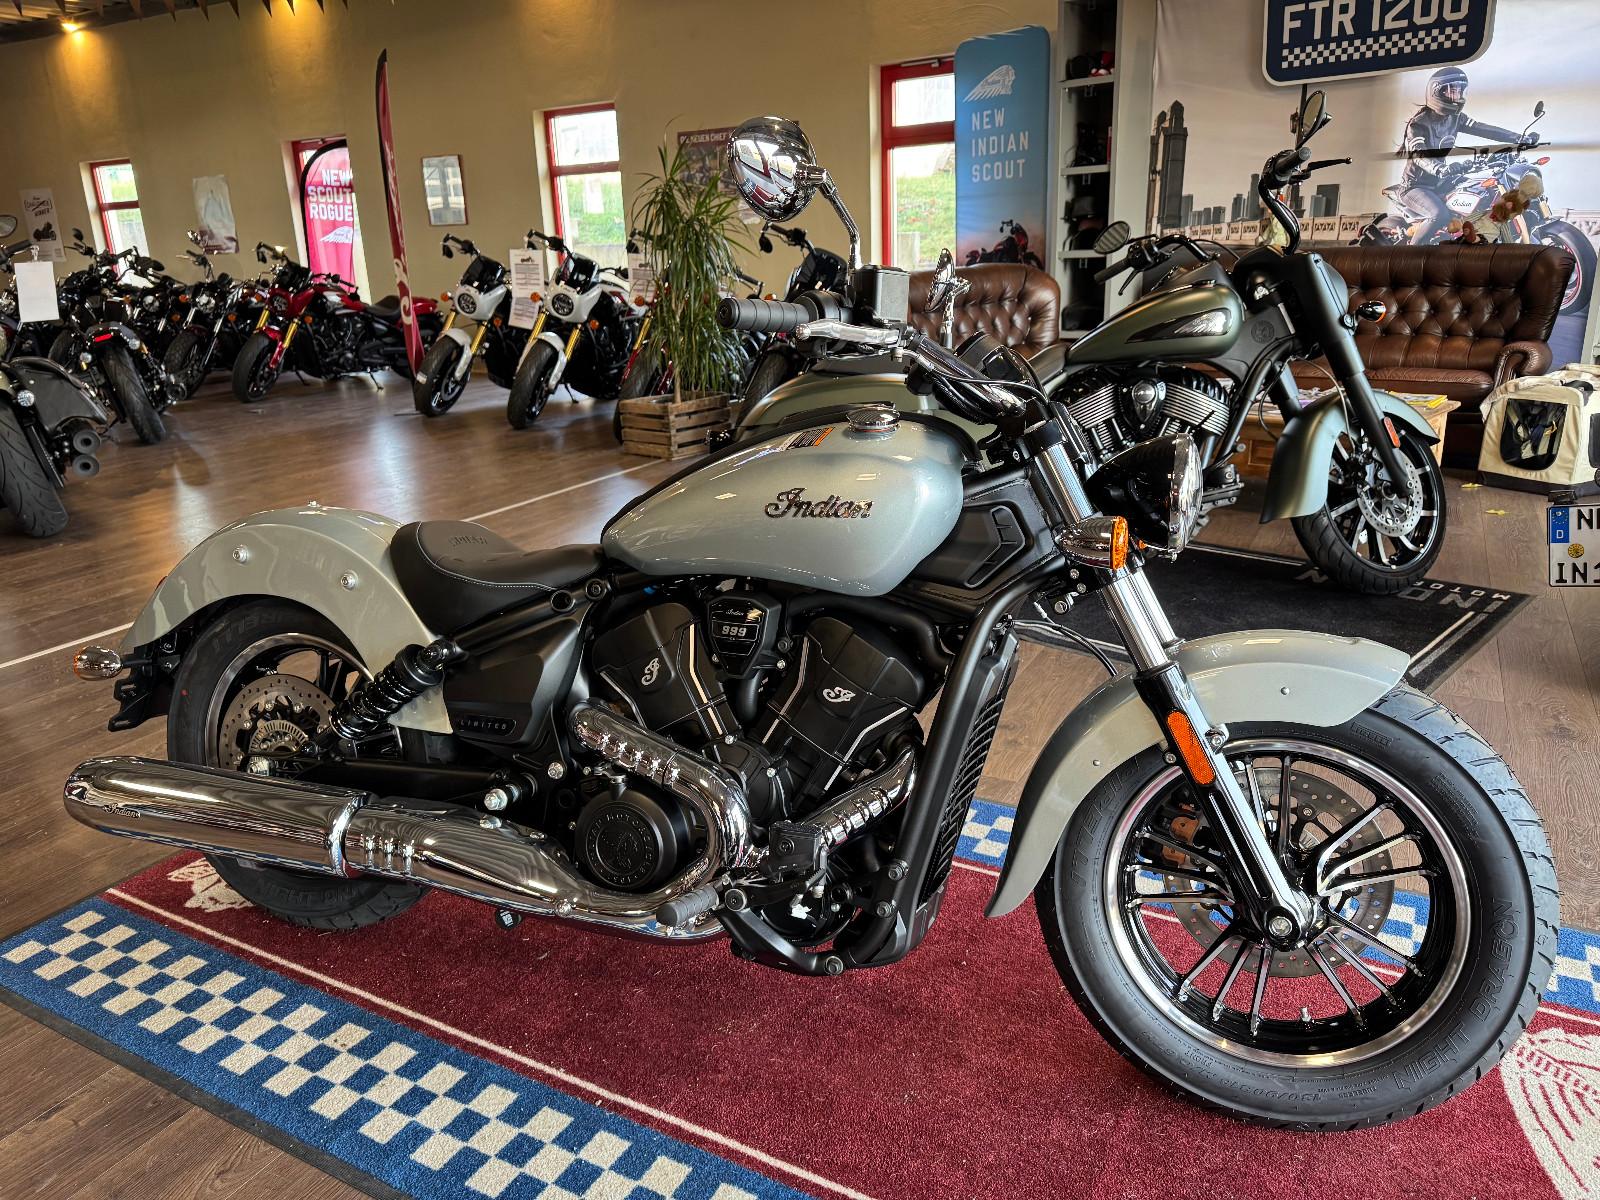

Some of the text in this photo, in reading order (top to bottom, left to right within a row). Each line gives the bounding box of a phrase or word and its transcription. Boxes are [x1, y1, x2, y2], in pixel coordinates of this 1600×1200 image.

[1282, 0, 1470, 44] FTR 1200
[972, 107, 1005, 131] NEW
[972, 131, 1029, 157] INDIAN
[321, 168, 353, 186] NEW
[972, 158, 1026, 183] SCOUT
[307, 185, 352, 204] SCOUT
[308, 202, 354, 222] ROGUE
[764, 487, 874, 519] Indian
[1577, 508, 1600, 530] N
[1556, 529, 1565, 539] D
[721, 625, 747, 637] 999
[459, 719, 508, 730] LIMITED
[102, 802, 139, 819] Indian
[1393, 898, 1518, 1089] NIGHT DRAGON
